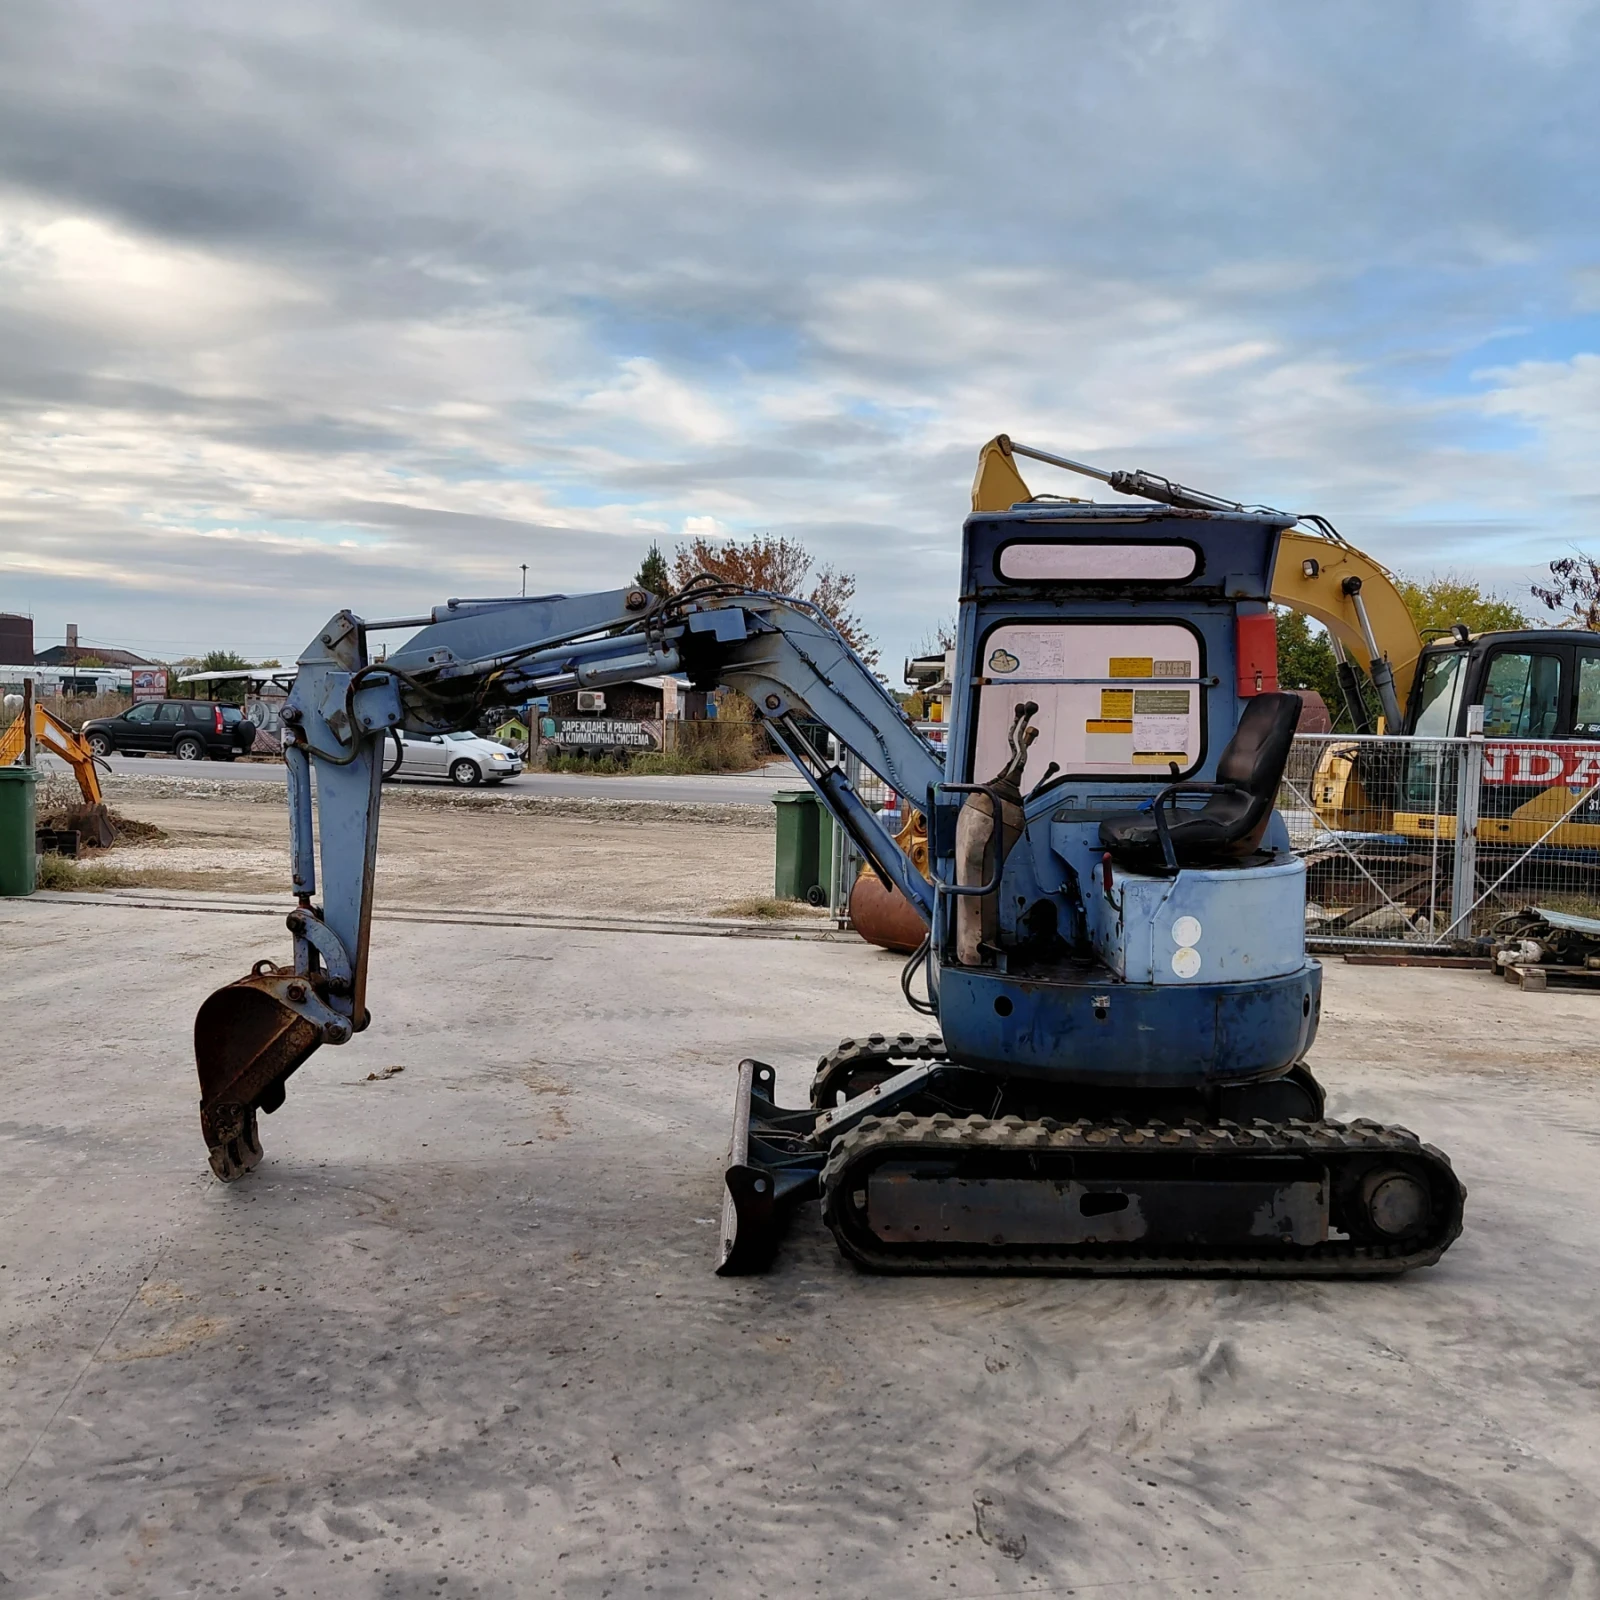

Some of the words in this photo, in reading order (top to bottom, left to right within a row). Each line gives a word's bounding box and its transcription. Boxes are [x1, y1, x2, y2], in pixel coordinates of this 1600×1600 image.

[561, 720, 606, 733] ЗАРЕЖДАНЕ
[607, 721, 613, 733] И
[613, 722, 642, 734] РЕМОНТ
[554, 731, 565, 743] НА
[565, 732, 615, 744] КЛИМАТИЧНА
[616, 733, 650, 745] СИСТЕМА
[1588, 798, 1600, 811] 31
